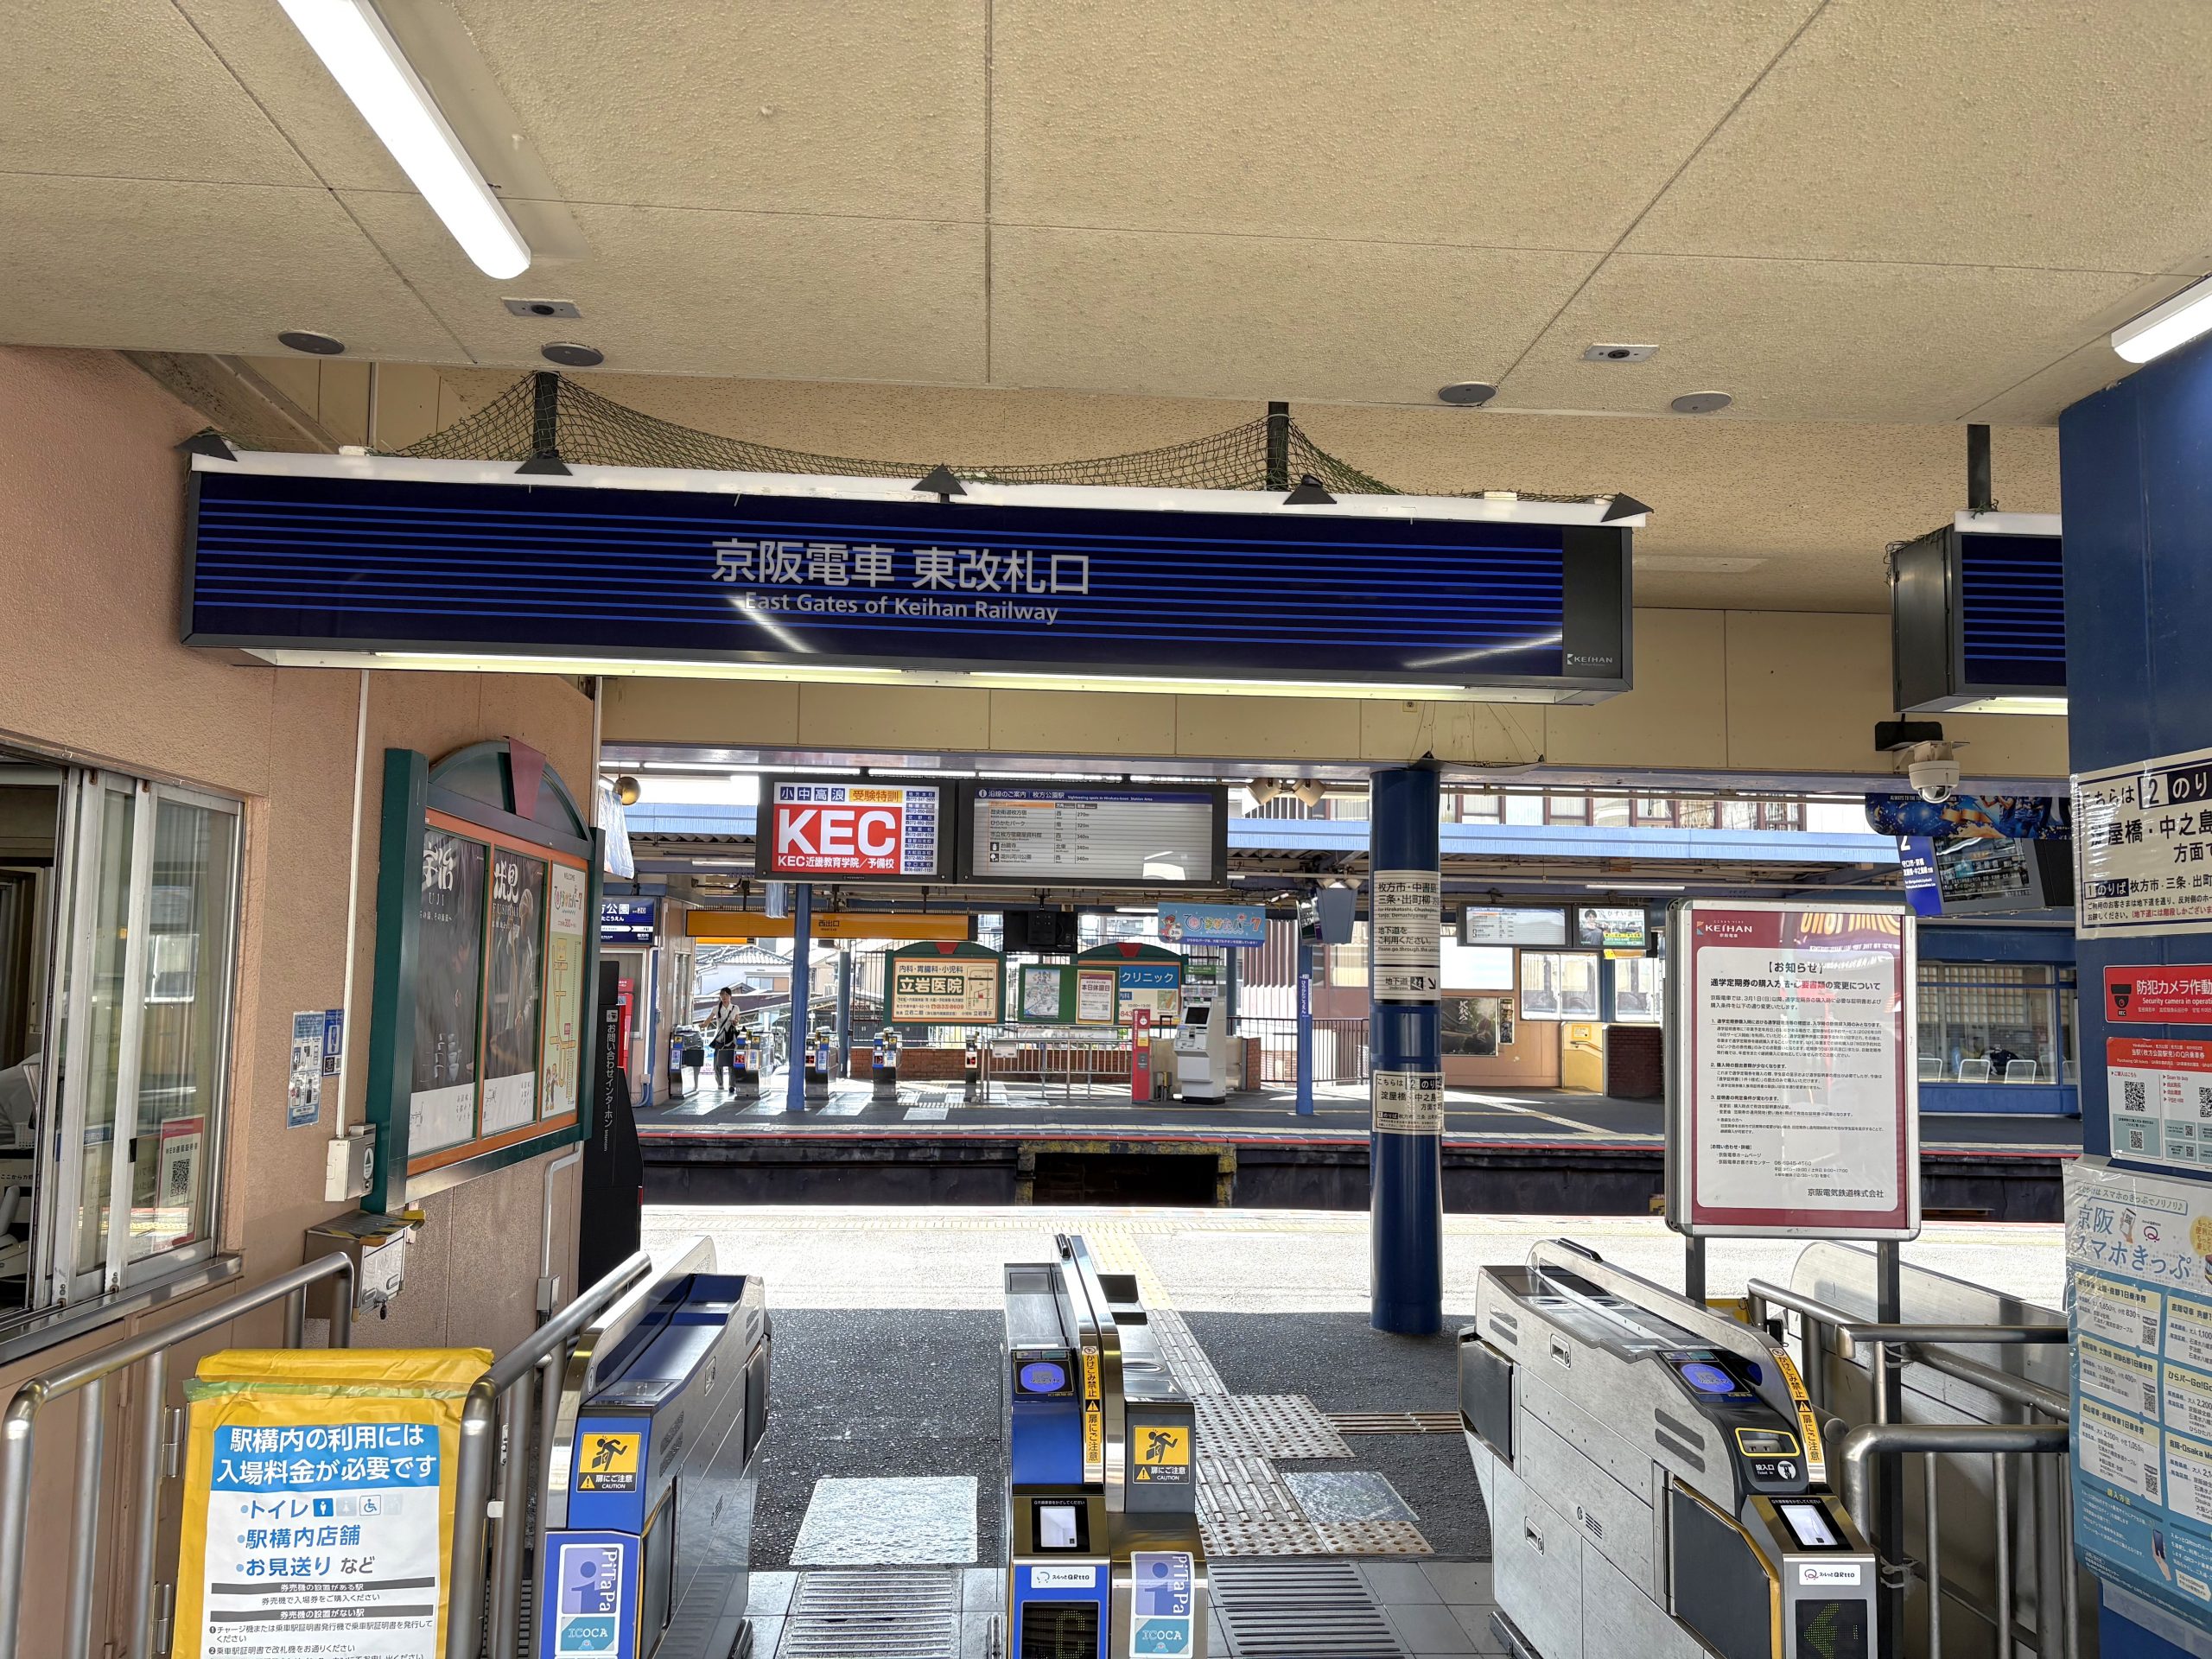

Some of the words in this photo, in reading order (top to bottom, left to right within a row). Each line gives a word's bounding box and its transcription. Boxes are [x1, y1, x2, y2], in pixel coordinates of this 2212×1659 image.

[711, 538, 895, 588] 京阪電車
[912, 546, 1089, 594] 東改札口
[745, 592, 790, 612] East
[797, 594, 858, 613] Gates
[865, 595, 887, 615] of
[895, 597, 968, 618] Keihan
[976, 602, 1058, 625] Railway
[778, 809, 896, 856] KEC
[2097, 881, 2126, 896] のりば
[1706, 925, 1752, 933] KEIHAN
[899, 965, 963, 974] 内科・胃腸科・小児科
[1769, 961, 1823, 974] 【お知らせ】
[899, 977, 963, 994] 立岩医院
[1385, 977, 1408, 986] 地下道
[2137, 979, 2212, 995] 防犯カメラ作動
[2143, 997, 2164, 1006] Security
[605, 1024, 616, 1128] お問い合わせインターホン
[1808, 1188, 1885, 1198] 京阪電気鉄道株式会社
[2077, 1204, 2115, 1235] 京阪
[2075, 1235, 2192, 1280] スマホきっぷ
[1086, 1355, 1097, 1397] かけこみ禁止
[231, 1424, 424, 1452] 駅構内の利用には
[1087, 1414, 1098, 1461] 扉にご注意
[216, 1455, 437, 1485] 入場料金が必要です
[1150, 1466, 1186, 1475] 扉にご注意
[596, 1474, 633, 1483] 扉にご注意
[249, 1500, 308, 1519] トイレ
[245, 1525, 361, 1549] 駅構内店舗
[245, 1556, 331, 1577] お見送り
[340, 1555, 376, 1574] など
[280, 1583, 364, 1592] 券売機の設置がある駅
[599, 1550, 618, 1611] PiTaPa
[1173, 1555, 1190, 1614] PiTaPa
[262, 1594, 380, 1605] 券売機で入場券をご購入ください
[280, 1608, 365, 1619] 券売機の設置がない駅
[216, 1635, 247, 1643] ください
[569, 1628, 608, 1638] ICOCA
[1142, 1630, 1182, 1641] ICOCA
